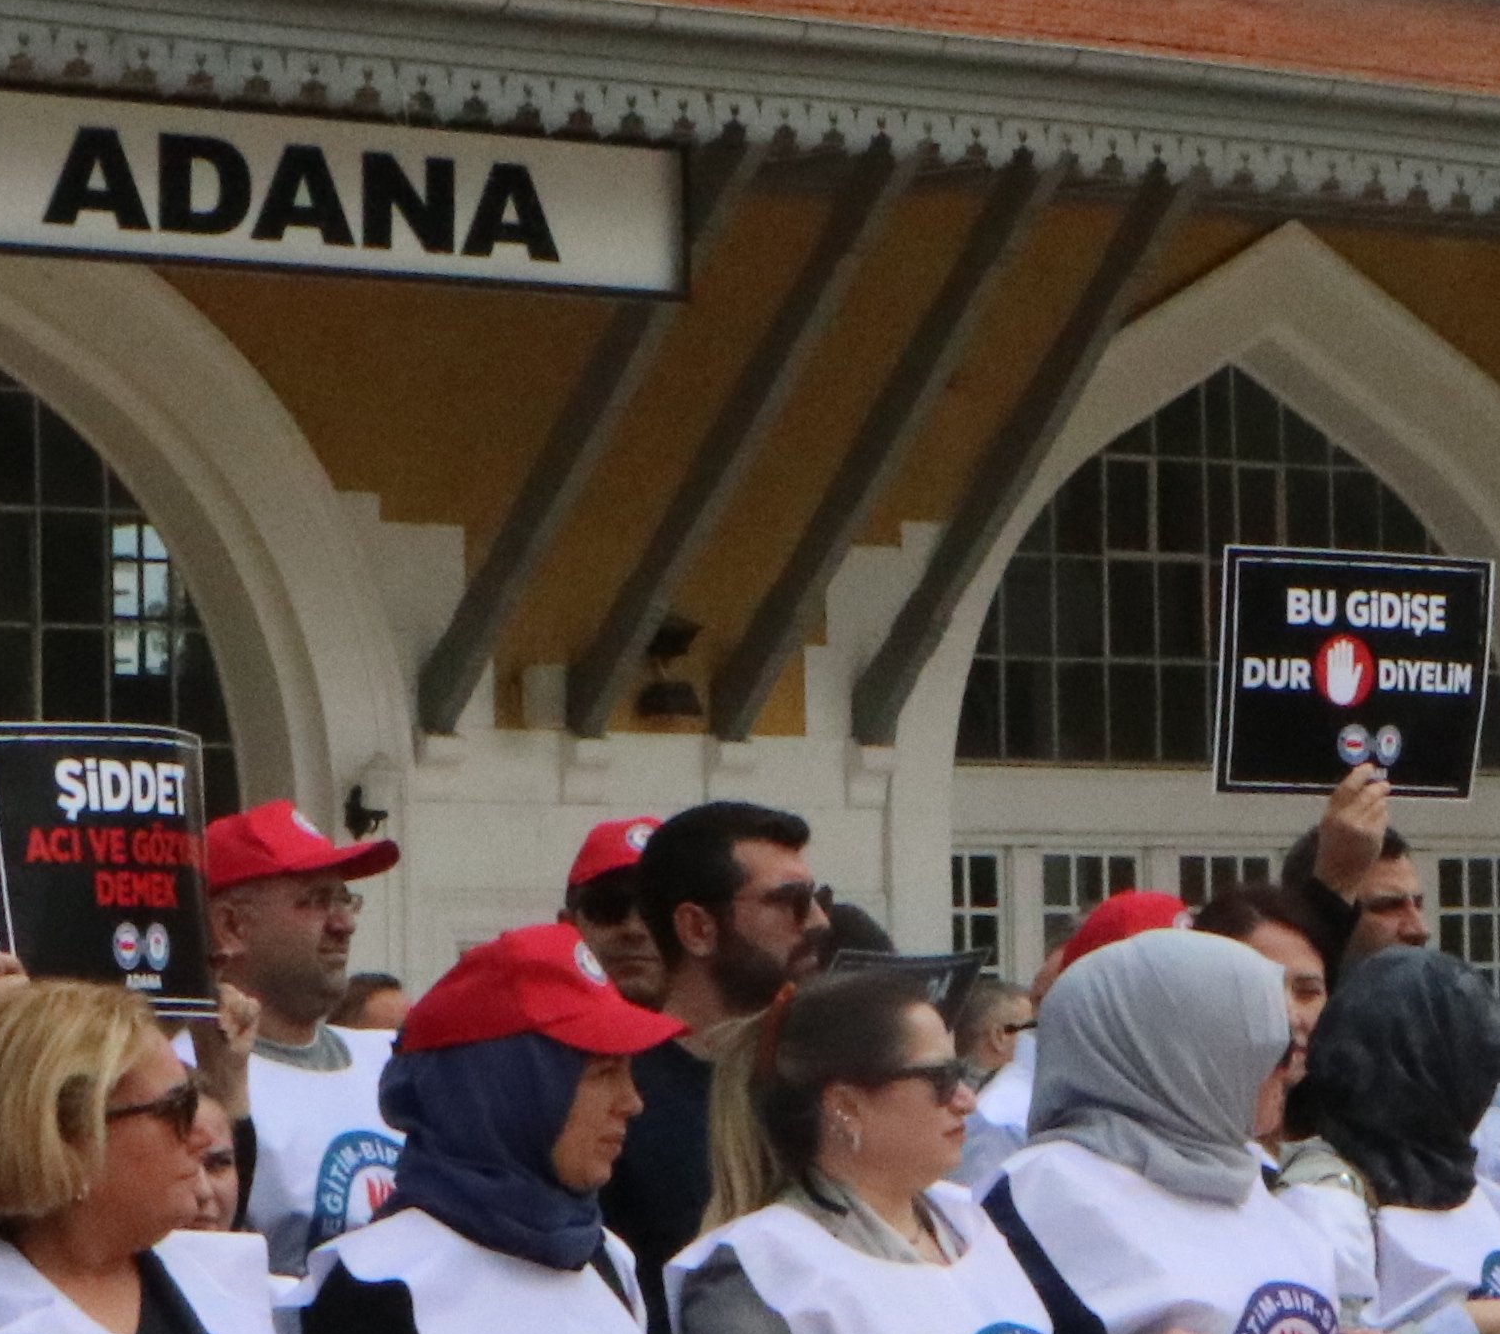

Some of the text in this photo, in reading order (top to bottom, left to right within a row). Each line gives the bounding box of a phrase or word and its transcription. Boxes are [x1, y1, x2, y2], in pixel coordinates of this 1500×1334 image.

[43, 125, 560, 263] ADANA
[1286, 587, 1447, 637] BU GİDİŞE
[1242, 657, 1472, 694] DUR DİYELİM
[54, 757, 186, 822] ŞİDDET
[25, 826, 82, 863] ACI
[88, 827, 128, 865] VE
[95, 870, 179, 907] DEMEK
